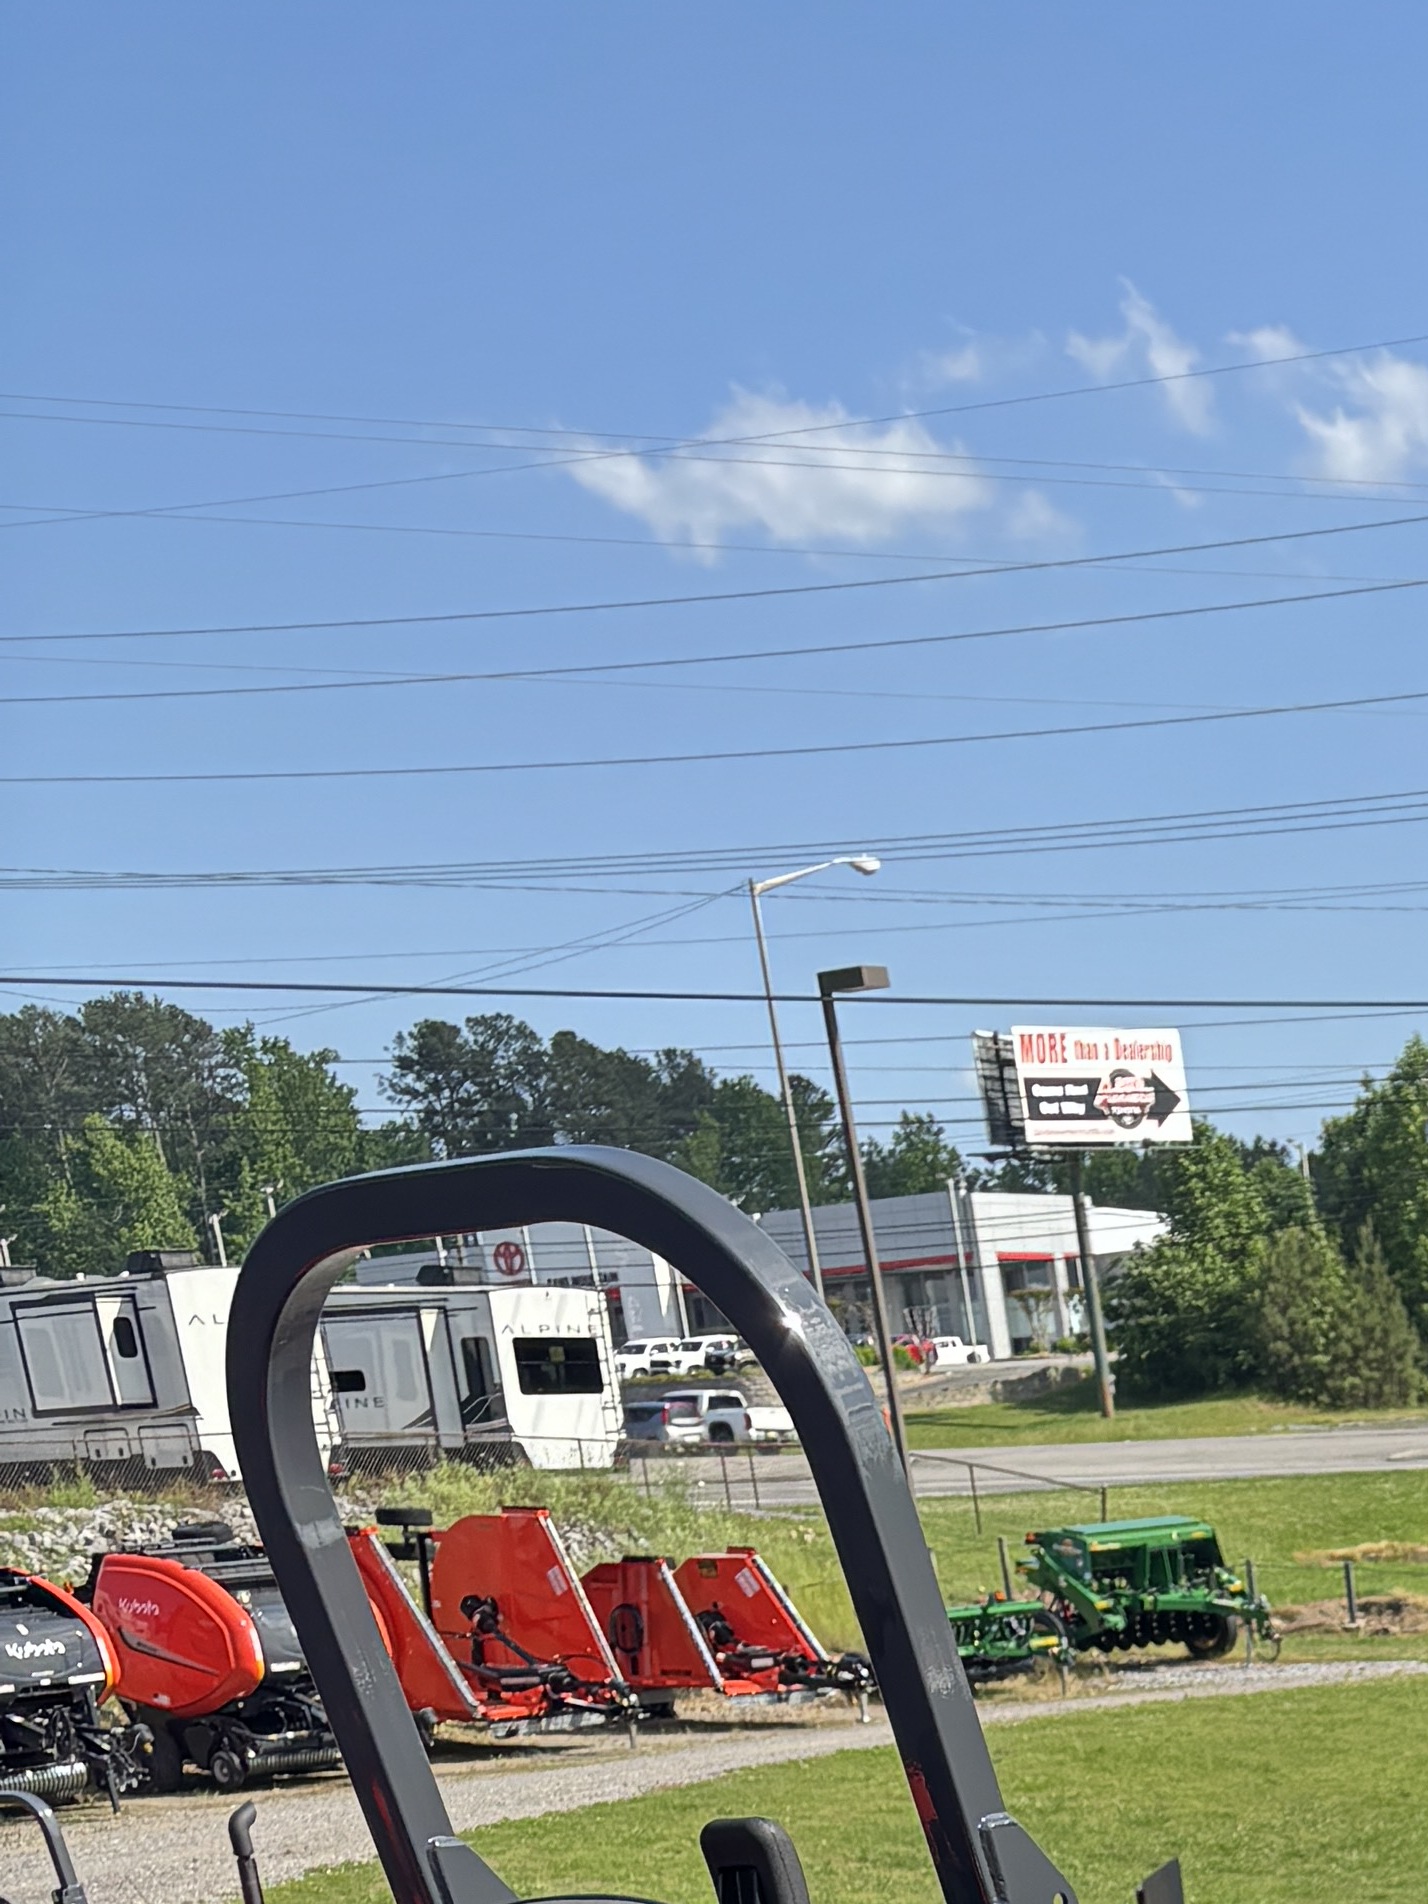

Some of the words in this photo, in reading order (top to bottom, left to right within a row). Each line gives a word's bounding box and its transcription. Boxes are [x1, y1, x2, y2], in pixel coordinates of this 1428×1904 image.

[1020, 1033, 1067, 1063] MORE
[502, 1324, 598, 1337] ALPINE
[5, 1638, 66, 1660] Kubota
